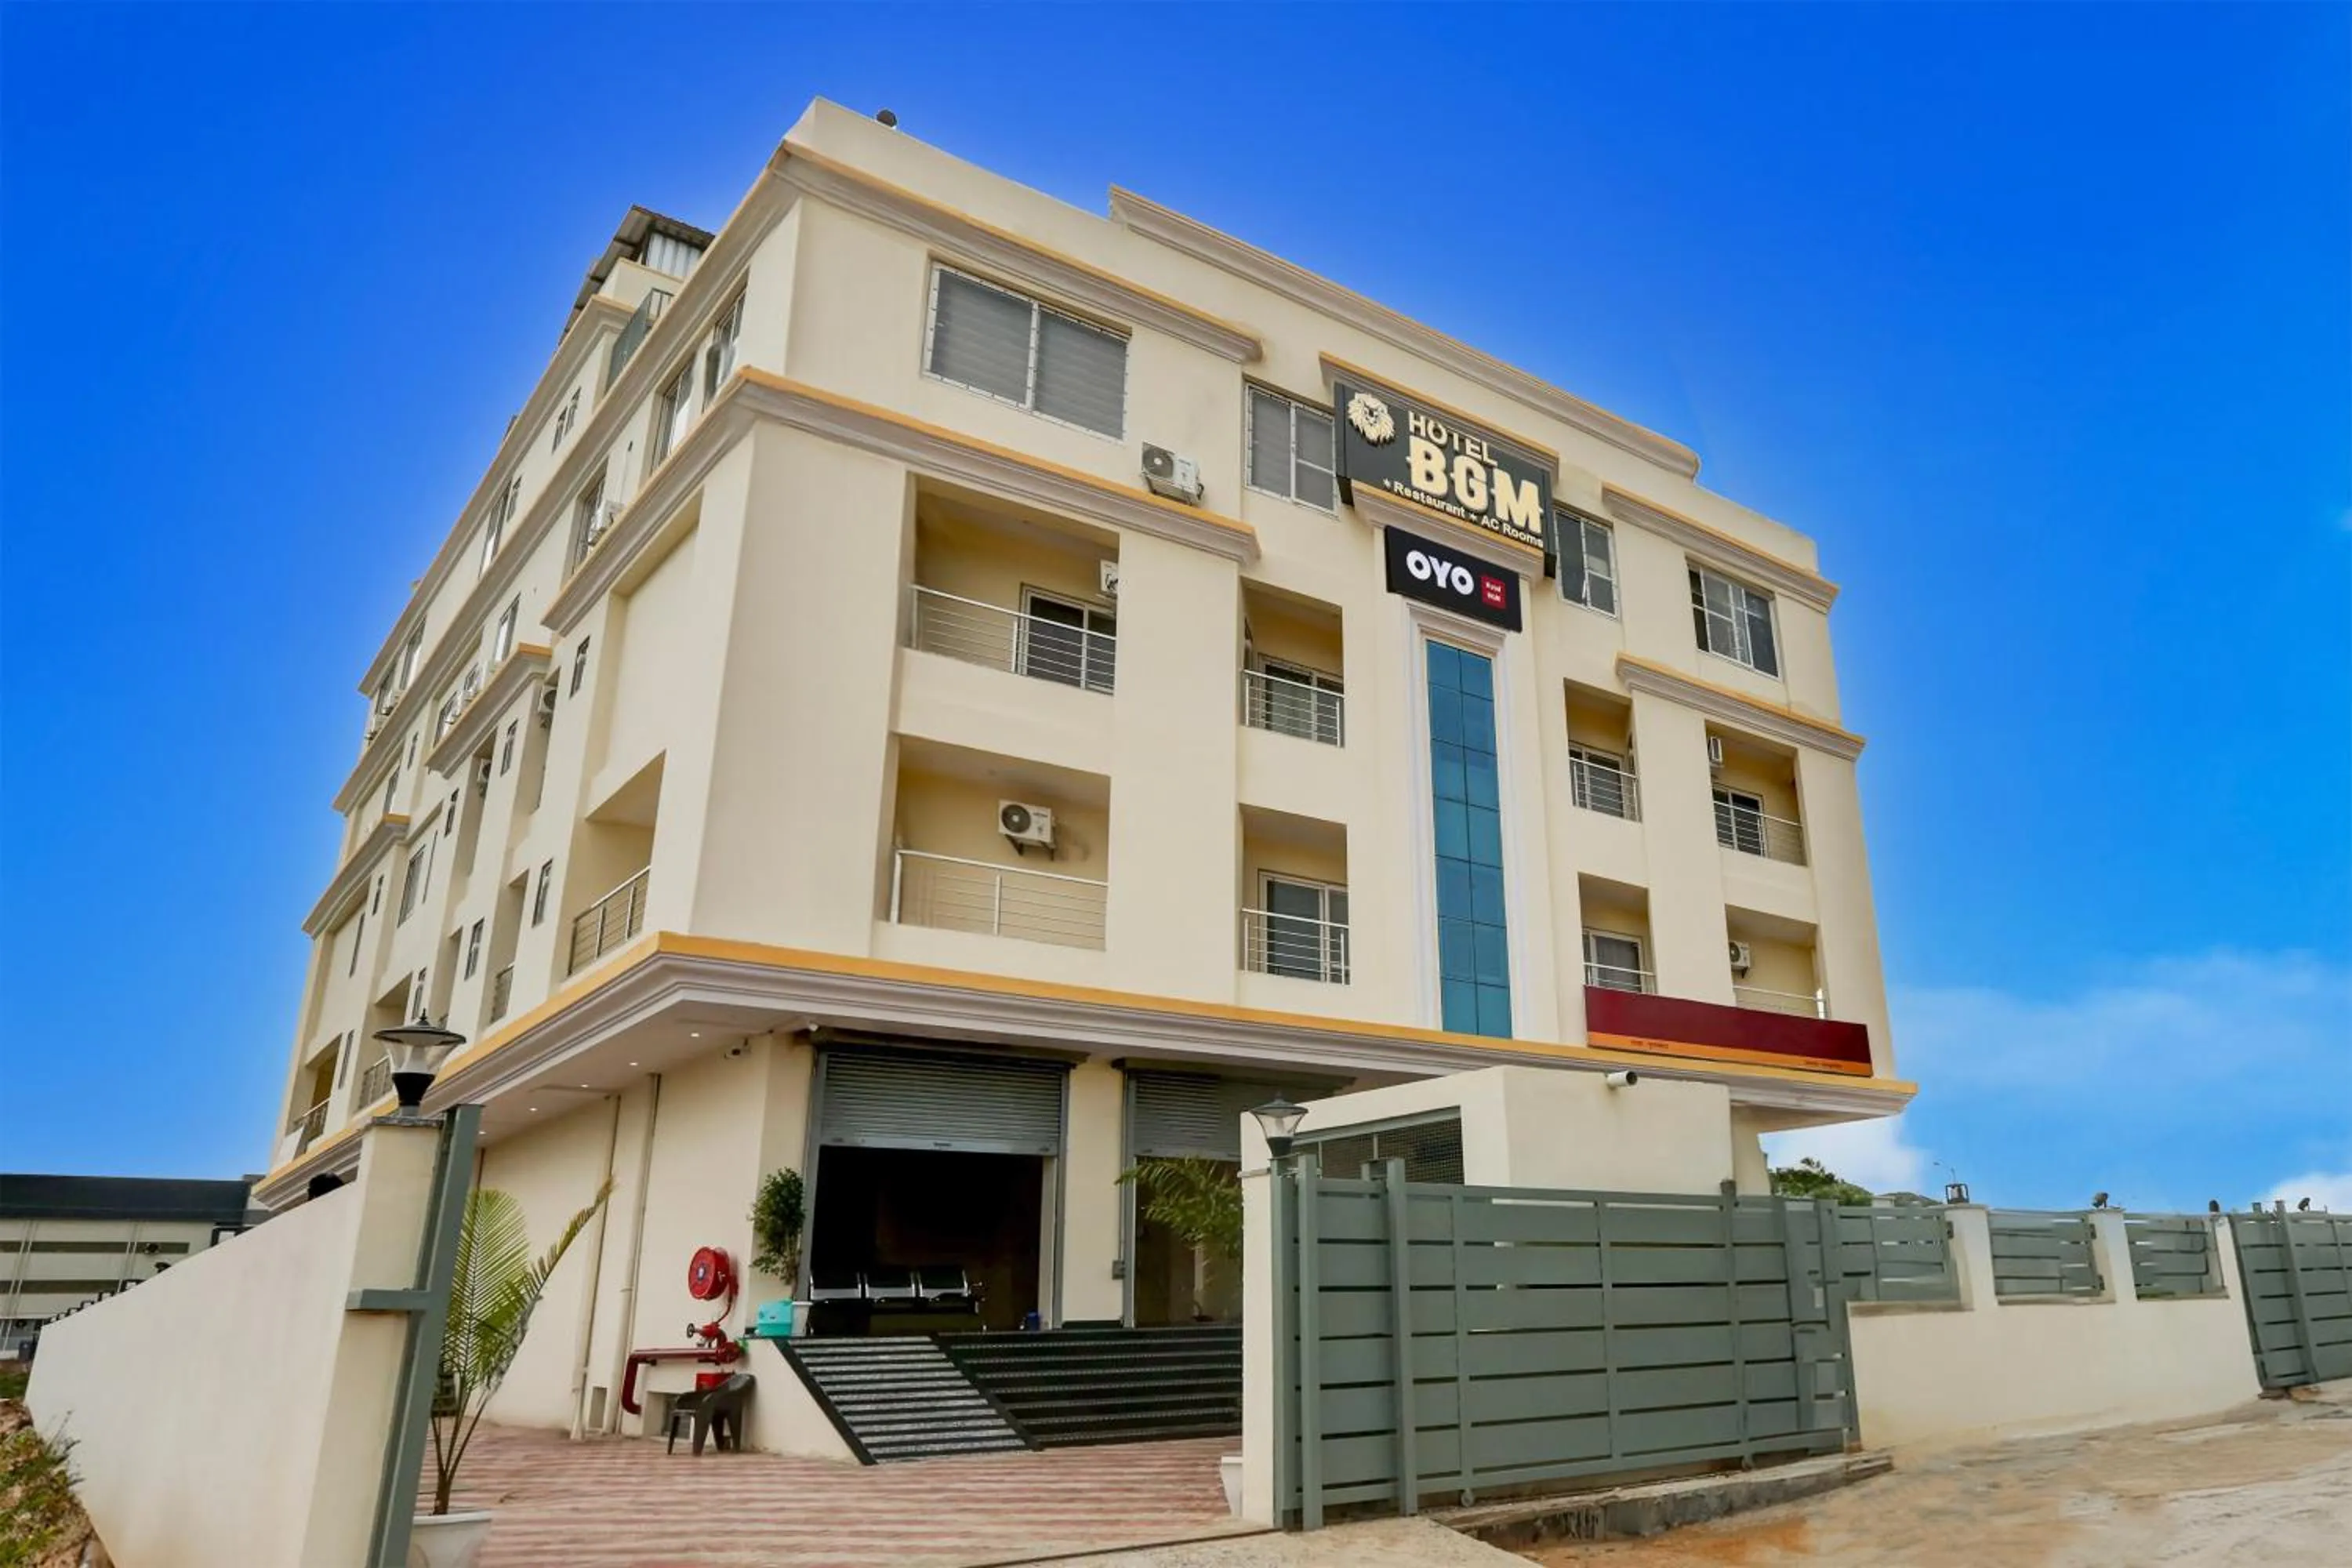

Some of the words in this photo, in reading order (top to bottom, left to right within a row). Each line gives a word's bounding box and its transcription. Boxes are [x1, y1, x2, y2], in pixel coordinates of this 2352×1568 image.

[1408, 410, 1497, 466] HOTEL
[1393, 481, 1465, 519] Restaurant
[1481, 514, 1500, 531] AC
[1503, 522, 1544, 547] Rooms
[1406, 434, 1544, 534] BGM
[1406, 550, 1475, 595] OYO
